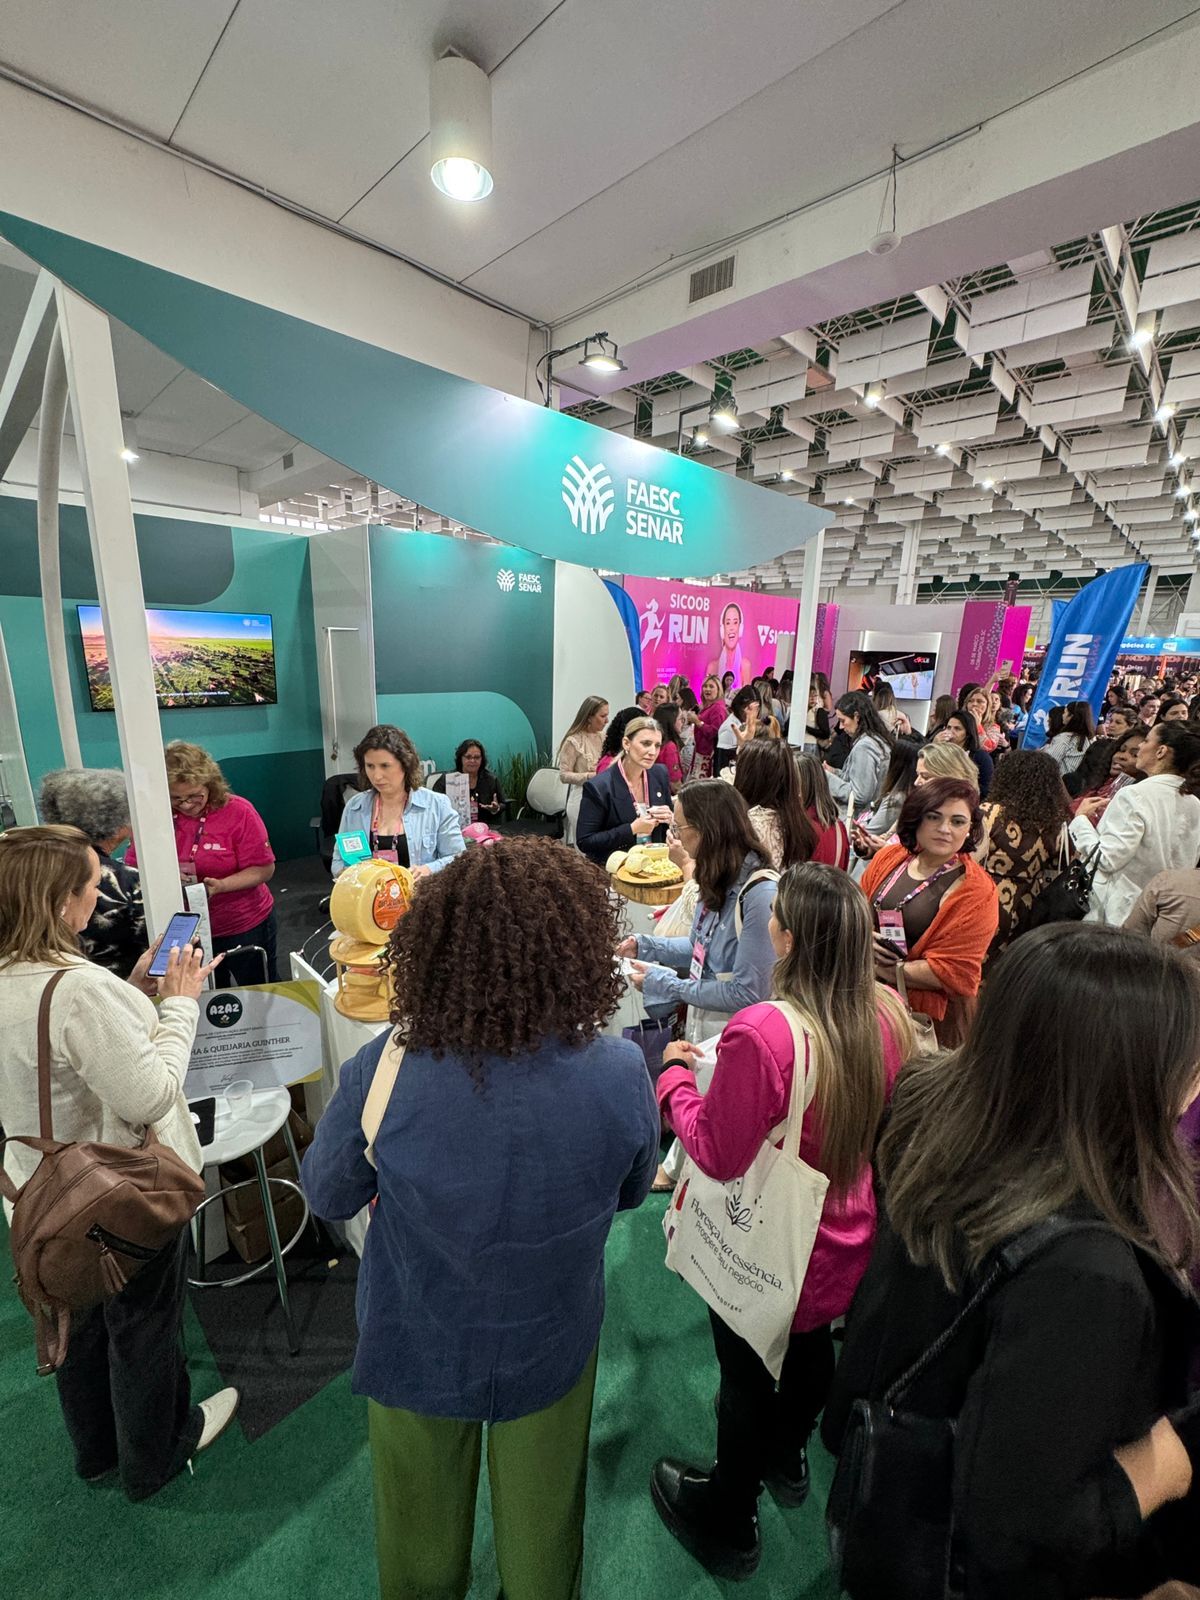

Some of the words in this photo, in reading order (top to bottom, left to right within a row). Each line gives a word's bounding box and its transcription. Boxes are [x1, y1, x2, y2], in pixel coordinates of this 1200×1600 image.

[626, 478, 681, 516] FAESC
[625, 510, 684, 545] SENAR
[518, 573, 541, 584] FAESC
[518, 583, 542, 593] SENAR
[670, 593, 710, 612] SICOOB
[668, 613, 709, 645] RUN
[1048, 633, 1094, 698] RUN
[210, 1040, 251, 1054] QUEIJARIA
[251, 1036, 291, 1048] GUINTHER
[691, 1198, 721, 1240] Floresça
[732, 1252, 784, 1291] essência.
[695, 1220, 719, 1255] Prospere
[727, 1265, 765, 1295] negócio.
